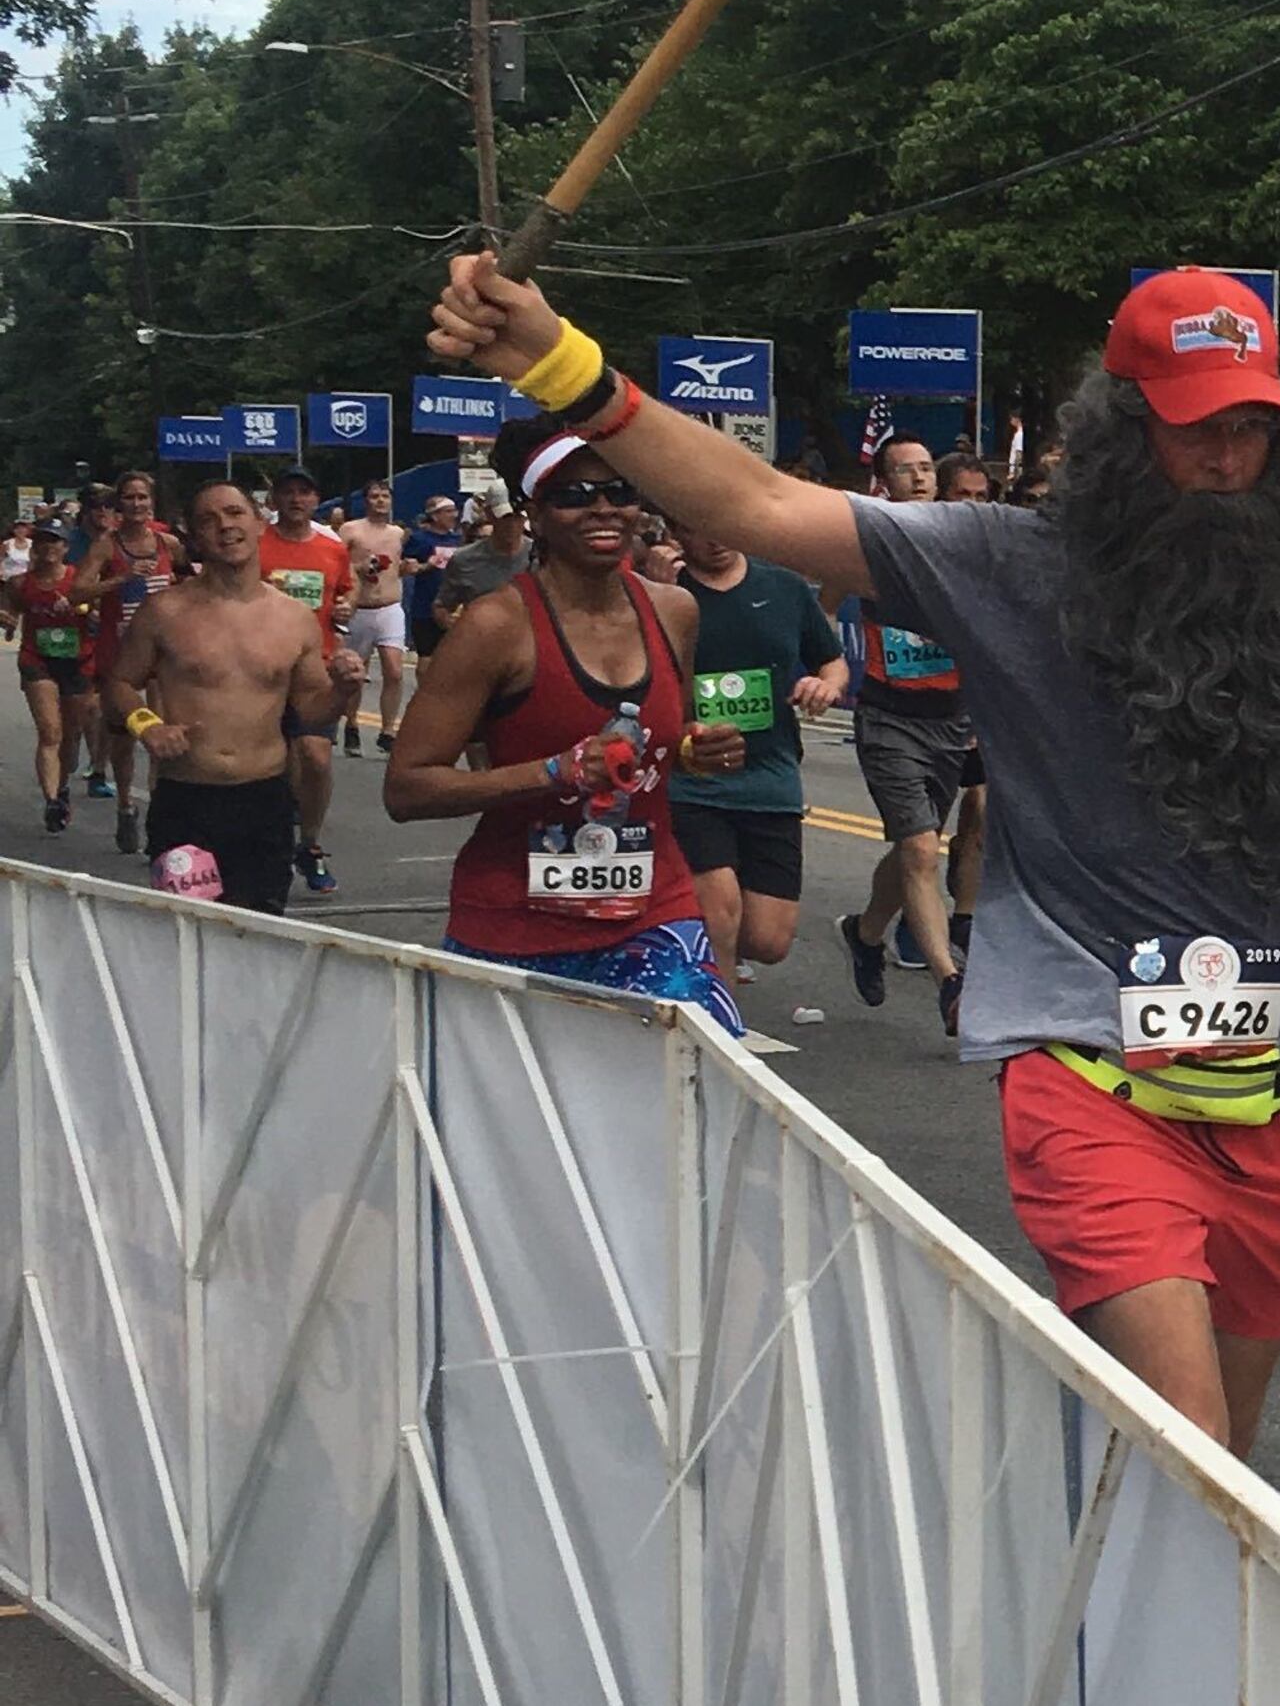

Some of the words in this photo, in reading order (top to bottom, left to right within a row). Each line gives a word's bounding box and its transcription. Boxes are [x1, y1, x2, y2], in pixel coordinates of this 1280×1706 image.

[858, 346, 968, 361] POWERADE
[434, 396, 496, 418] ATHLINKS
[333, 413, 365, 432] ups
[165, 432, 221, 446] DASANI
[886, 650, 898, 665] D
[698, 702, 710, 718] C
[716, 697, 771, 716] 10323
[543, 866, 562, 890] C
[571, 865, 643, 890] 8508
[1140, 1004, 1167, 1038] C
[1179, 1001, 1270, 1037] 9426
